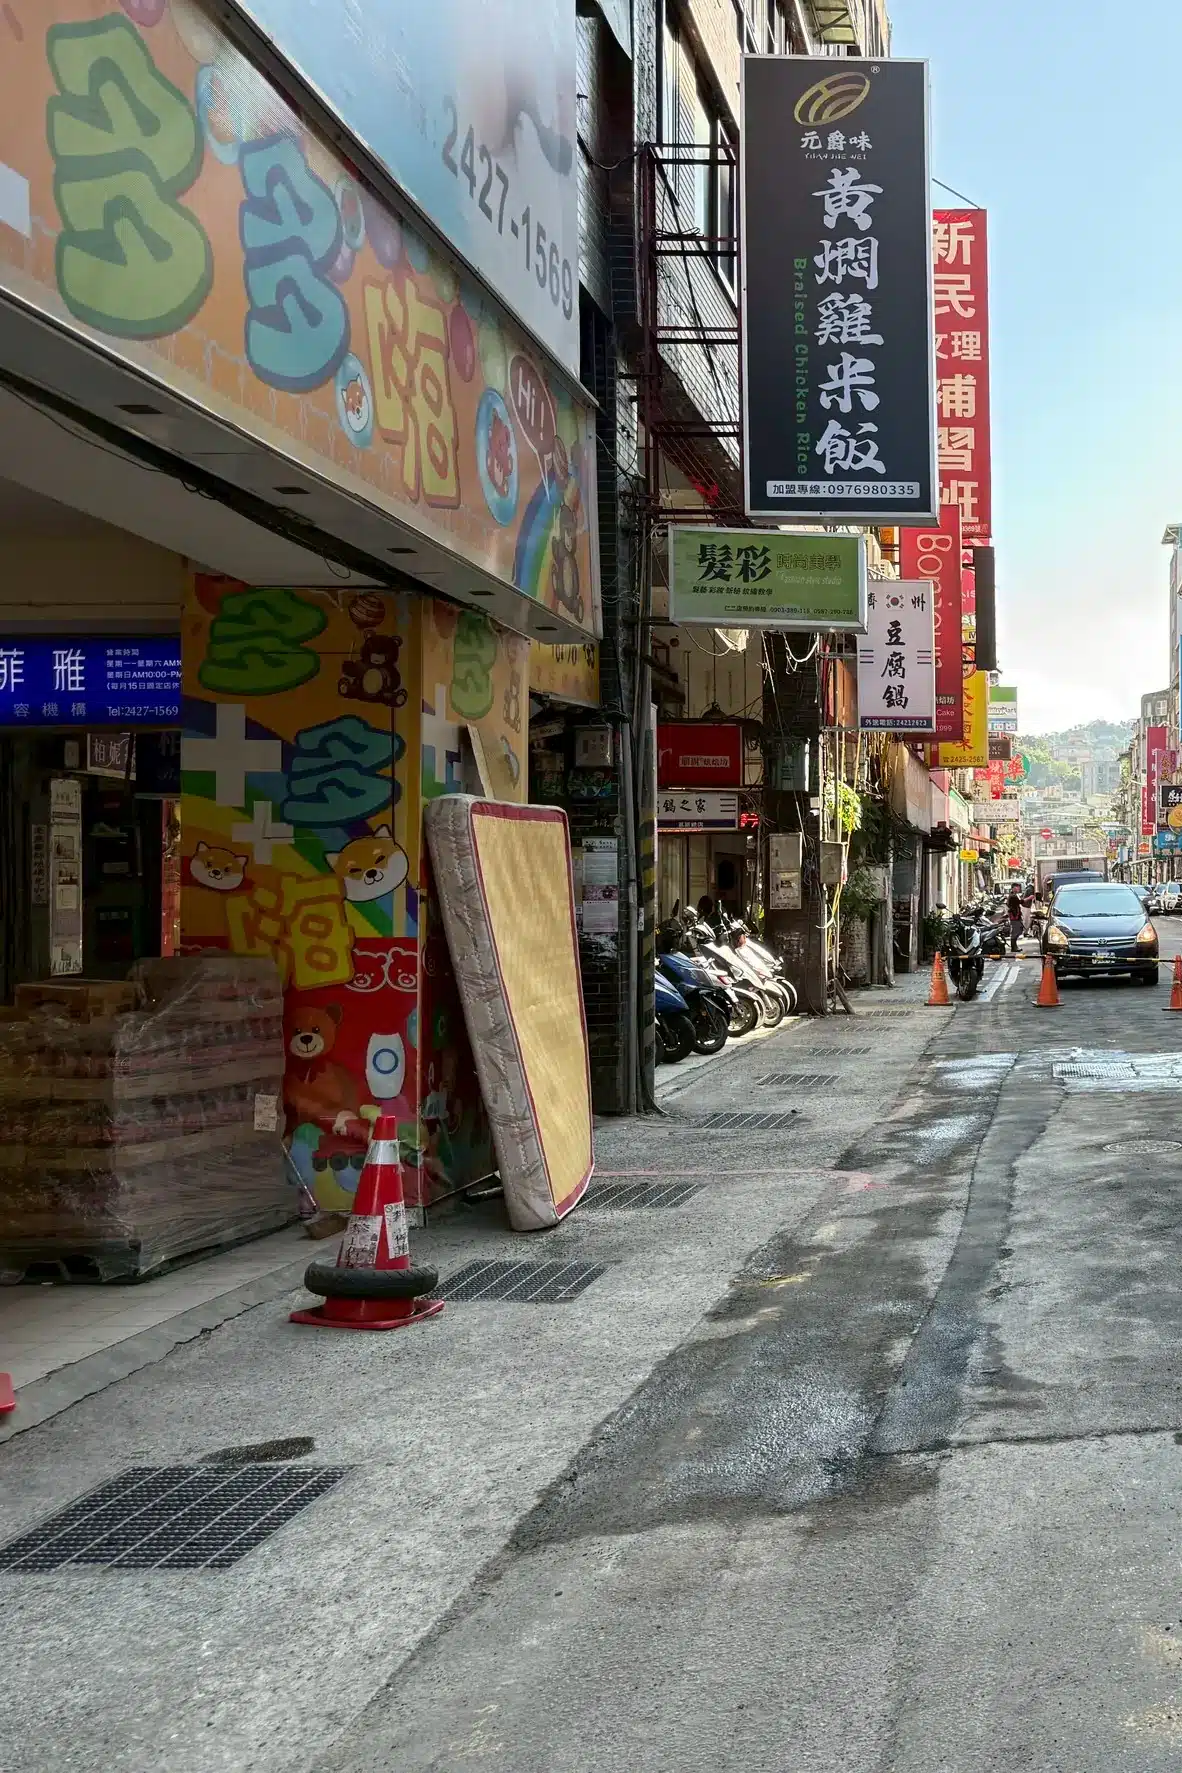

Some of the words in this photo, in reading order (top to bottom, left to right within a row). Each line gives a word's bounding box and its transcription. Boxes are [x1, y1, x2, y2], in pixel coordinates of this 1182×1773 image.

[801, 131, 873, 151] 元爵味
[441, 95, 574, 322] 2427-1569
[793, 257, 809, 337] Braised
[812, 167, 886, 474] 黃燜雞米飯
[794, 343, 810, 424] Chicken
[796, 432, 809, 476] Rice
[697, 543, 773, 584] 髮彩
[881, 619, 909, 710] 豆腐鍋
[936, 709, 955, 717] Cake
[657, 798, 707, 813] 鍋之家
